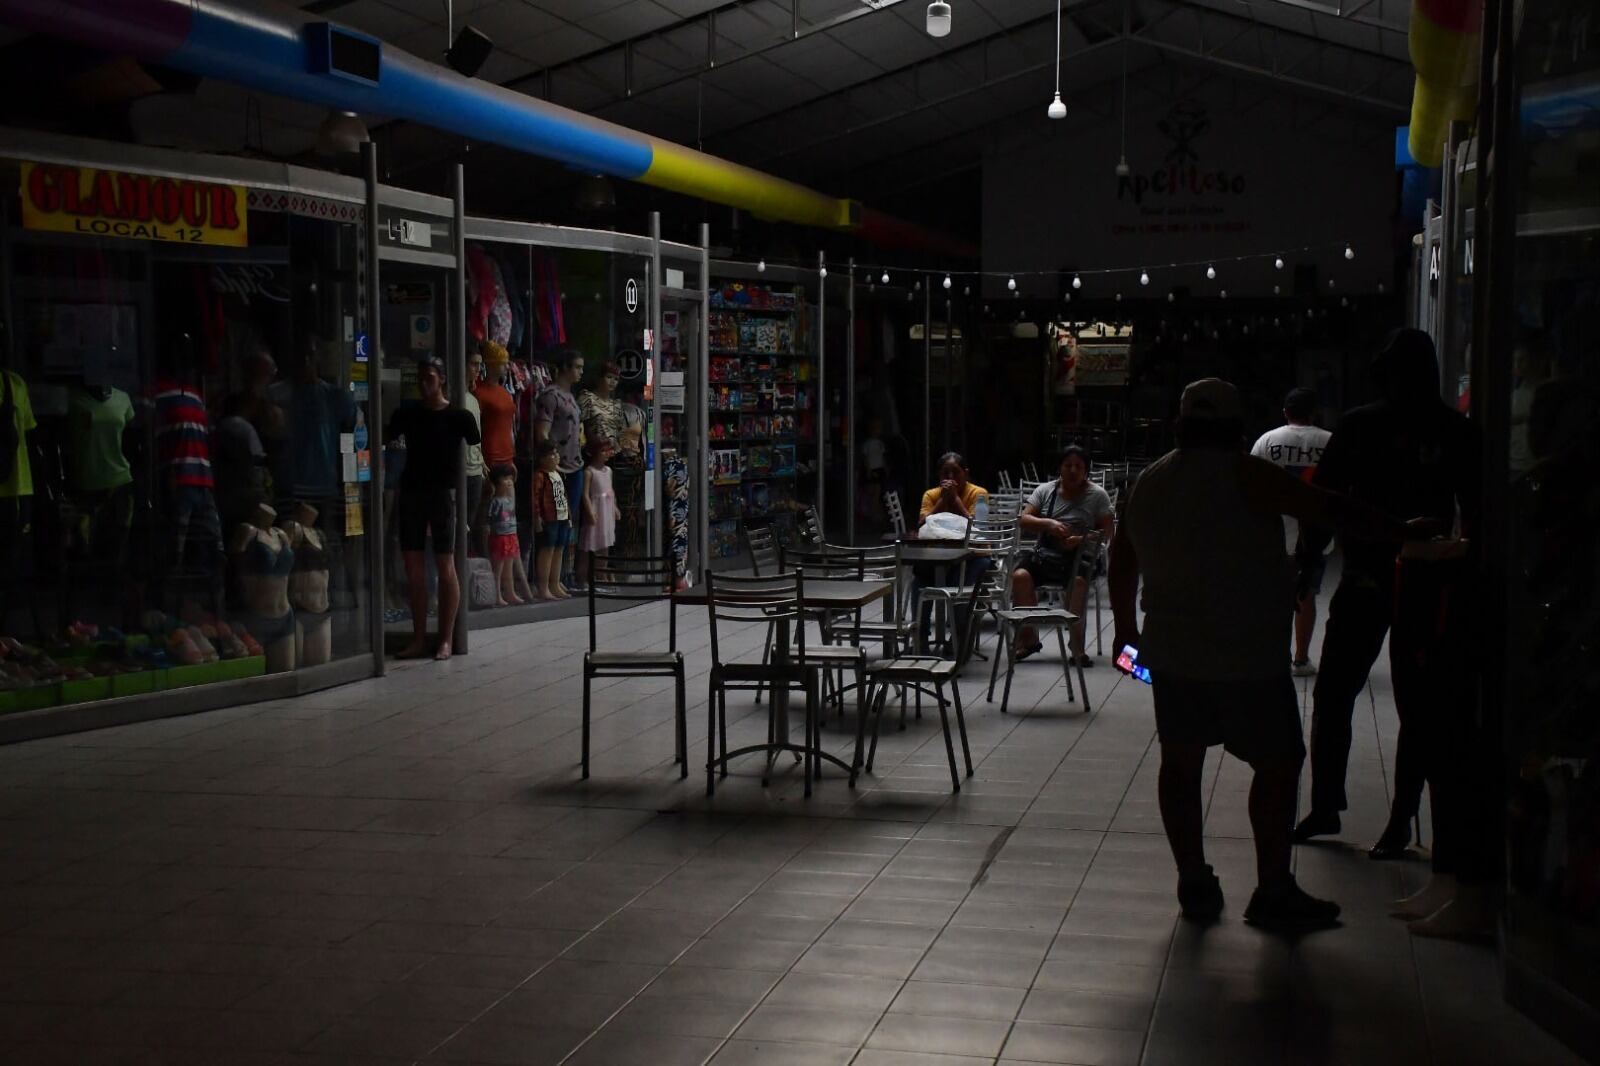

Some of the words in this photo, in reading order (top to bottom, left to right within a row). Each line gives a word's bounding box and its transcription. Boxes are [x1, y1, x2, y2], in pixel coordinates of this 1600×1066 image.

[28, 163, 240, 230] GLAMOUR
[75, 218, 167, 240] LOCAL
[175, 229, 203, 242] 12
